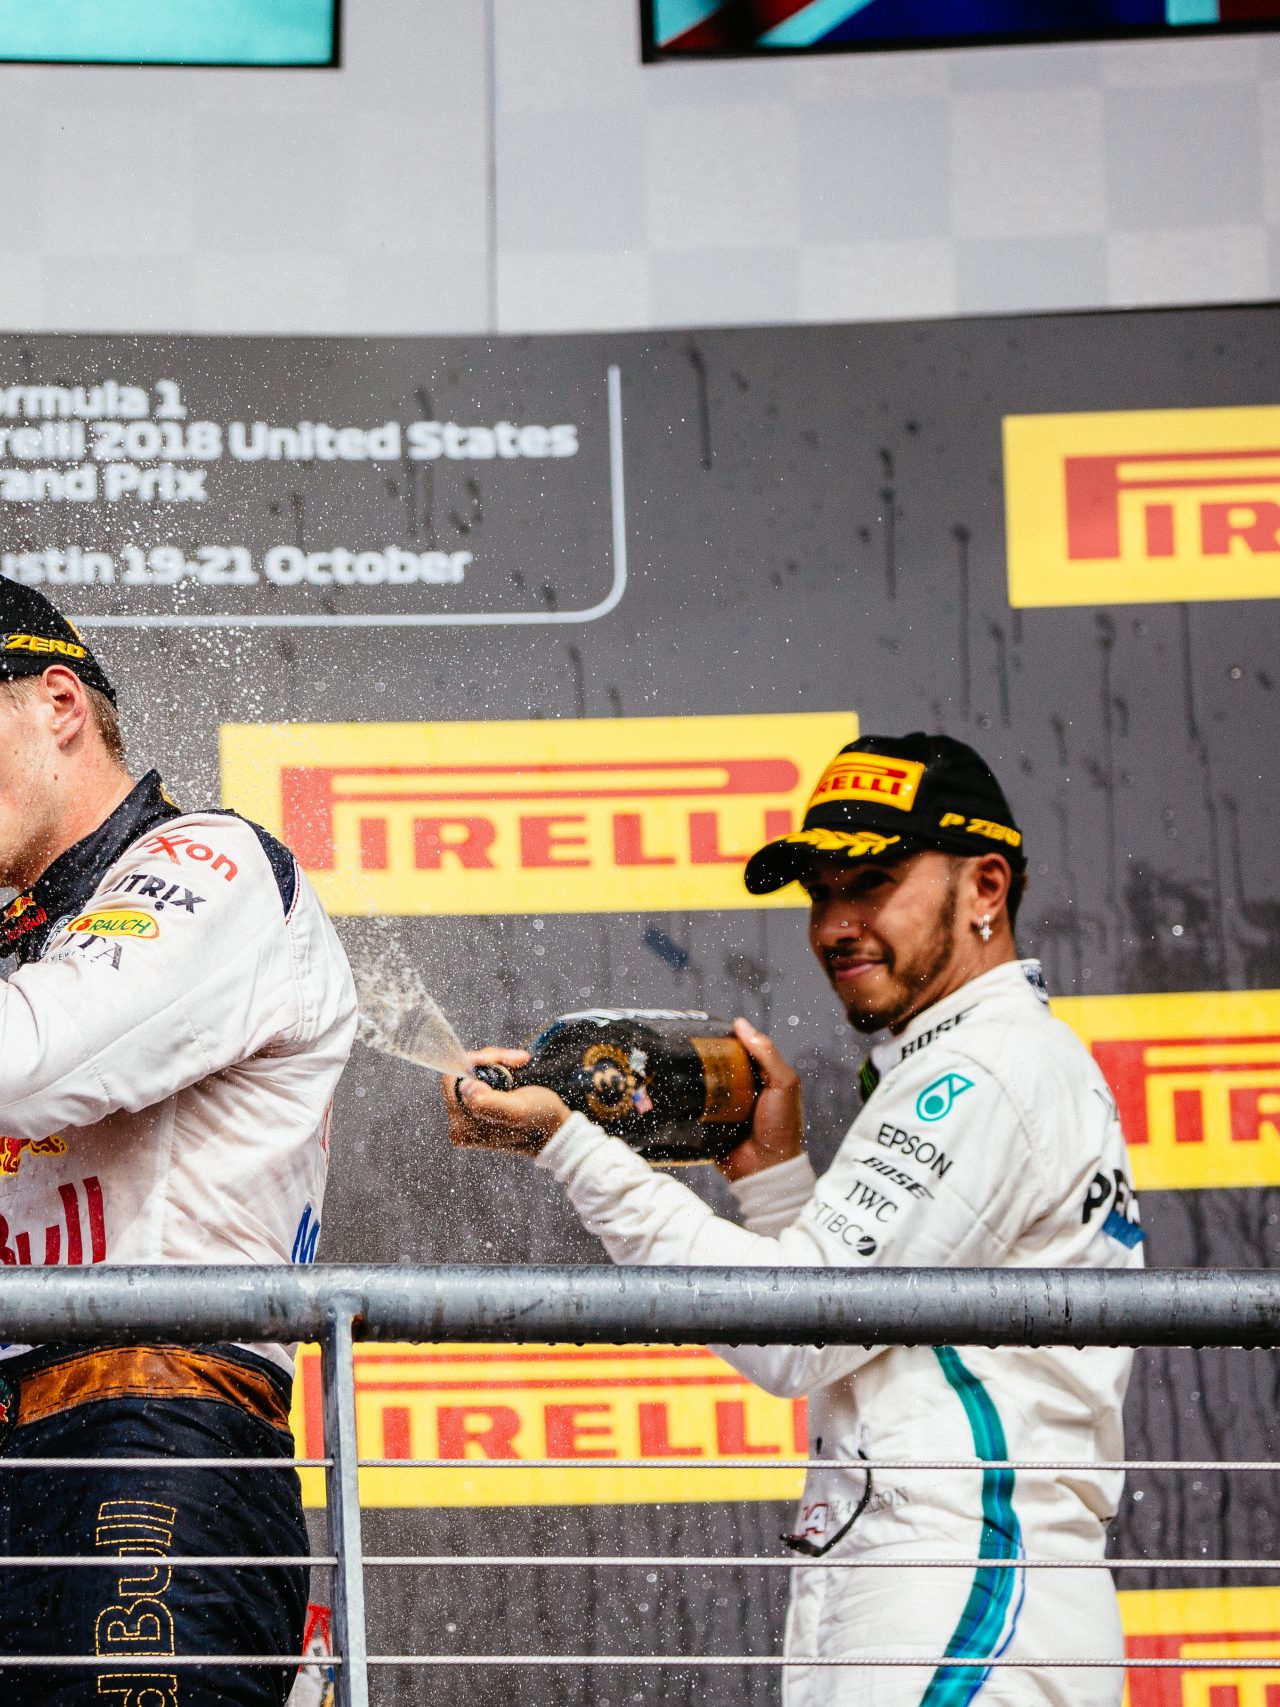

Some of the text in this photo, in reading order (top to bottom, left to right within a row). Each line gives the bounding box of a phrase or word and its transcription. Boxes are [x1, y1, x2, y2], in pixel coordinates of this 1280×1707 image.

[155, 381, 185, 419] 1
[91, 422, 221, 460] 2018
[230, 422, 402, 460] United
[408, 423, 578, 459] States
[104, 463, 207, 500] Prix
[122, 547, 260, 584] 19-21
[264, 548, 473, 584] October
[4, 634, 88, 659] ZERO
[939, 812, 966, 828] P
[101, 873, 207, 914] ITRIX
[89, 918, 152, 935] RAUCH
[900, 1003, 979, 1061] BOSE
[877, 1122, 953, 1179] EPSON
[854, 1156, 935, 1201] BOSE
[845, 1179, 898, 1223] IWC
